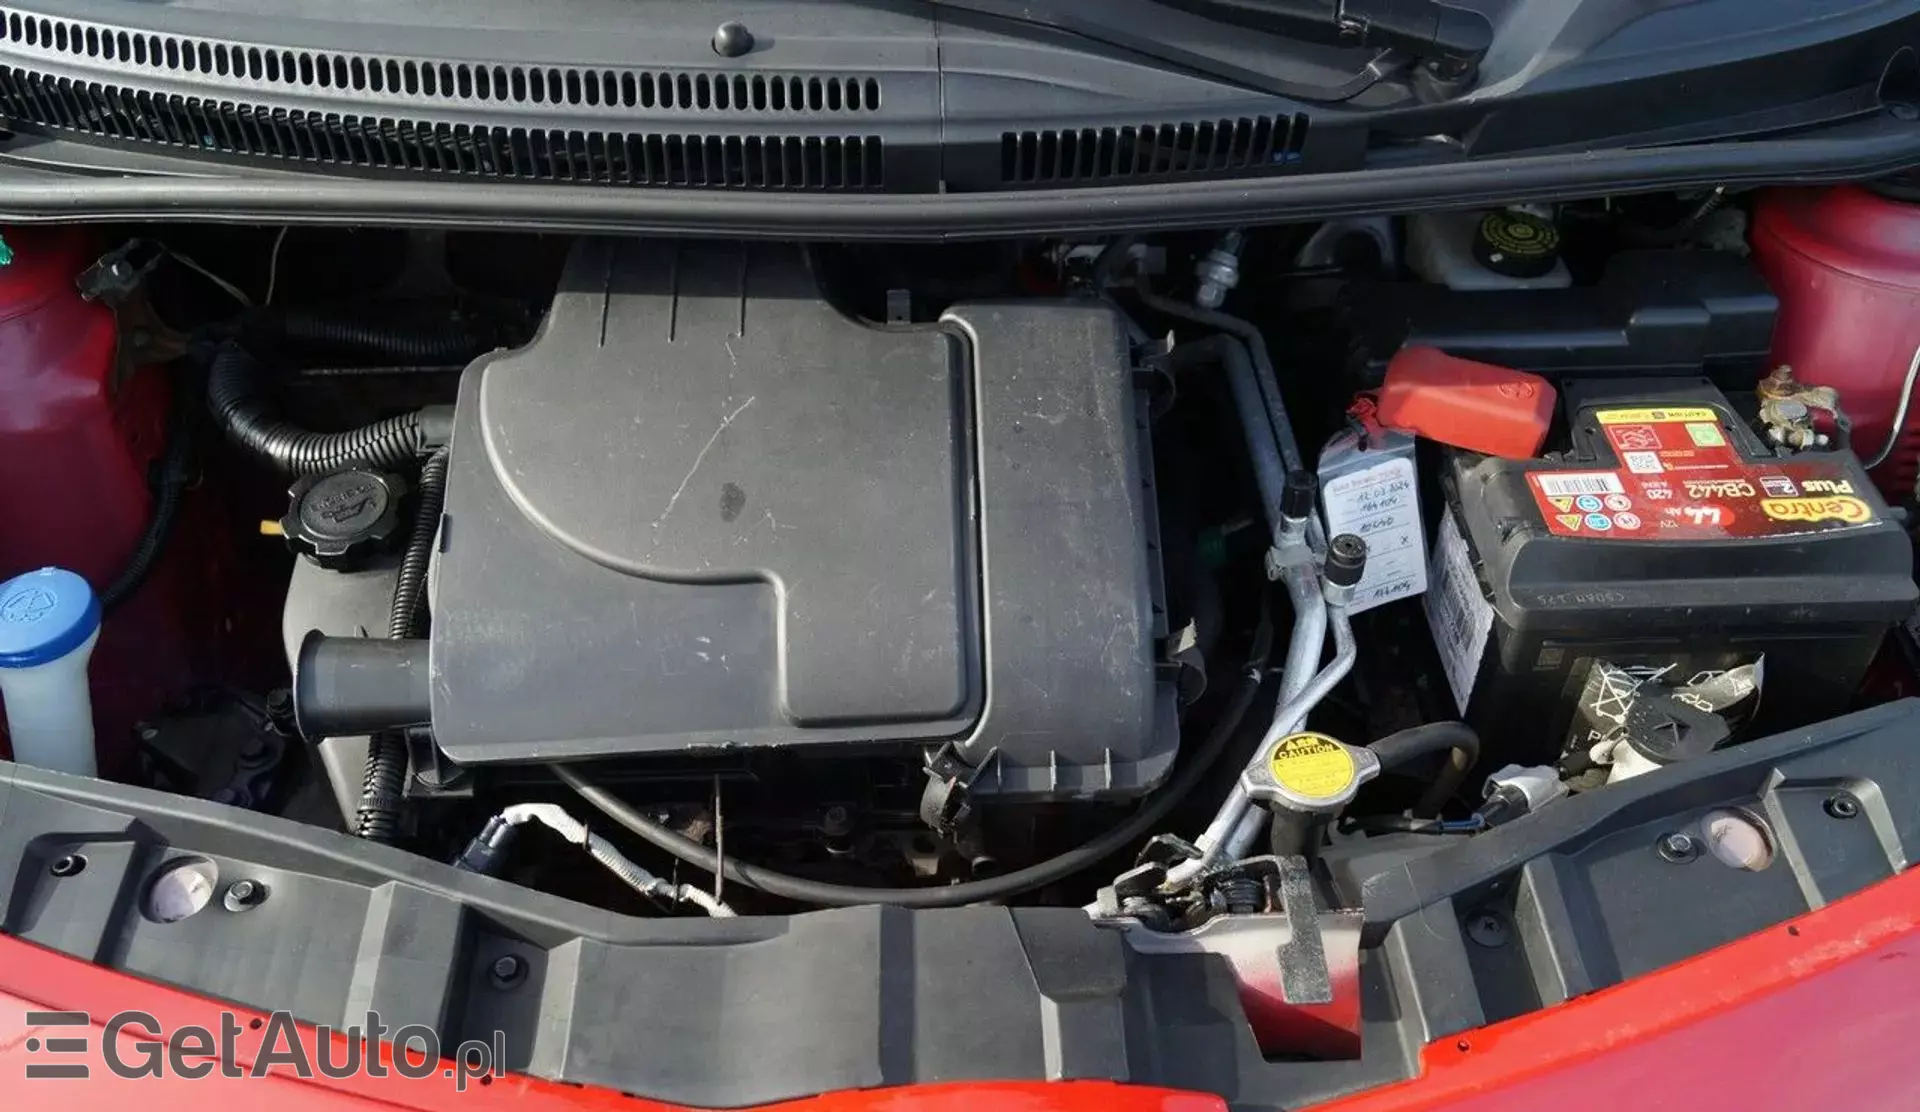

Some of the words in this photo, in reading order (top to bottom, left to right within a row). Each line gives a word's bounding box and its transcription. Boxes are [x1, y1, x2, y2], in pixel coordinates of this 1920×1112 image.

[1688, 483, 1756, 499] CB442
[1801, 480, 1854, 495] Plus
[1683, 507, 1721, 526] 44
[1769, 499, 1865, 519] Centra
[1278, 744, 1334, 760] CAUTION
